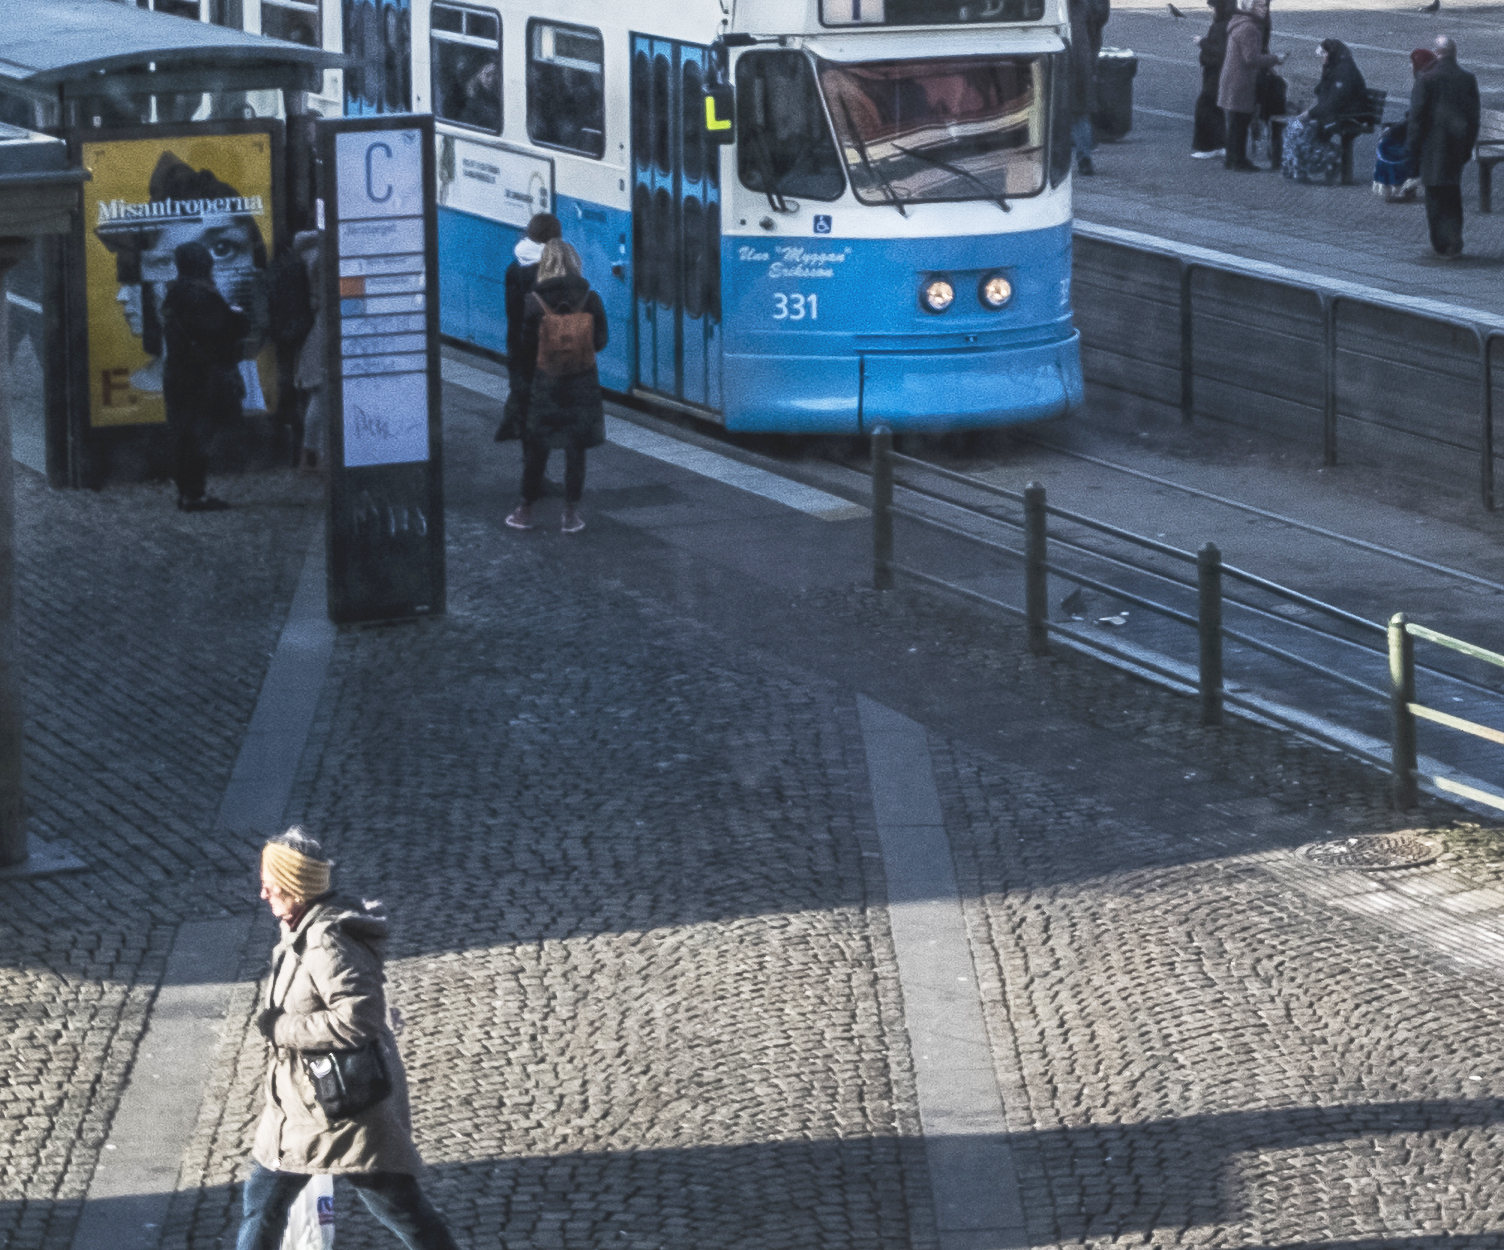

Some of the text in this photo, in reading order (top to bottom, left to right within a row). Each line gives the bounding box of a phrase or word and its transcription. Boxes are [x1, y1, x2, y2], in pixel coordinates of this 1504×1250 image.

[365, 141, 393, 203] C
[98, 196, 264, 222] Misantroperna
[772, 292, 818, 320] 331
